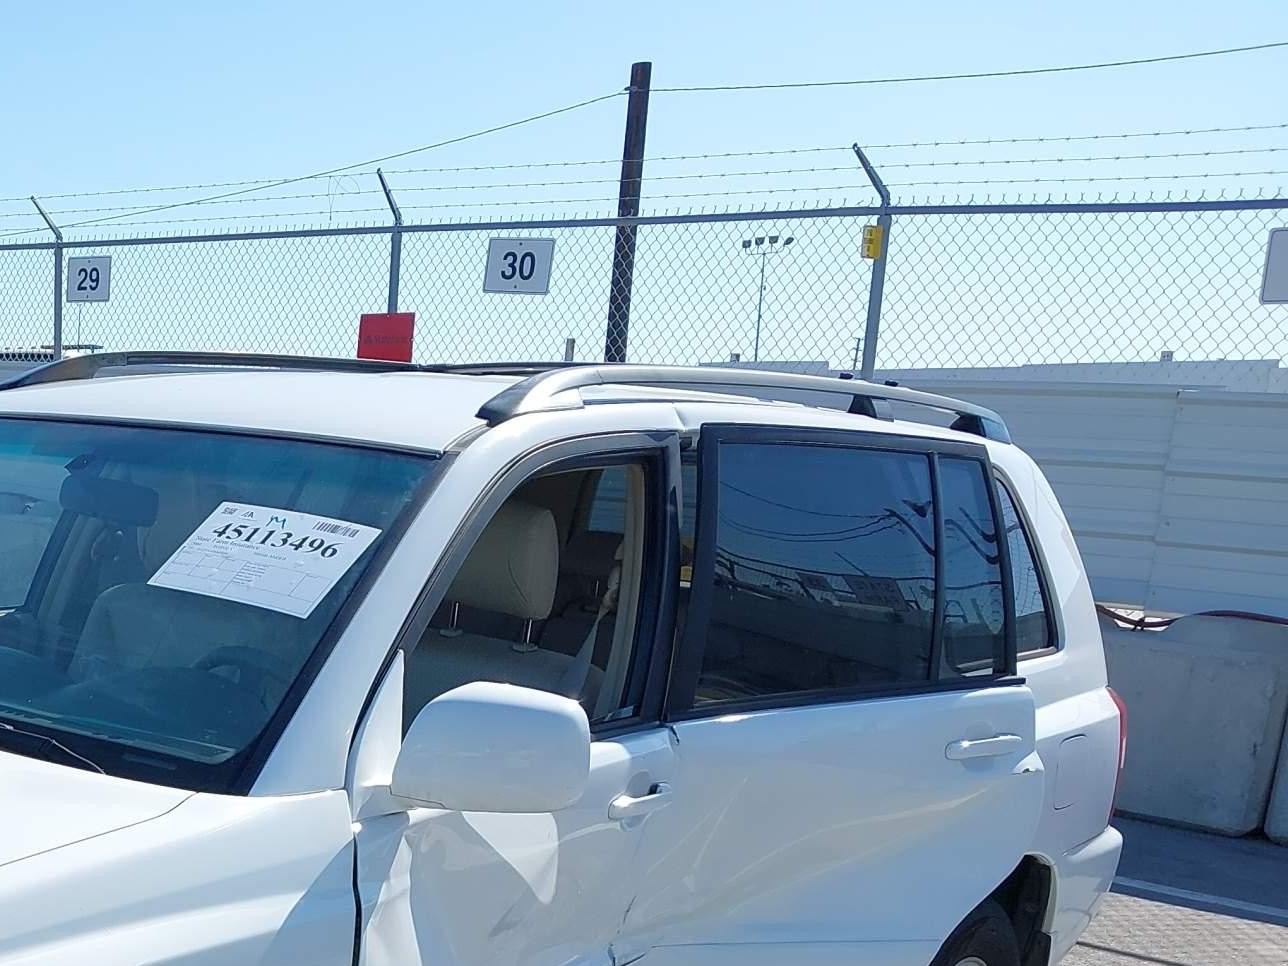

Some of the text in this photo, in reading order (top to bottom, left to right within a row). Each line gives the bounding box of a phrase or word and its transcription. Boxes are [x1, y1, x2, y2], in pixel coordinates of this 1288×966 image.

[76, 267, 100, 291] 29
[500, 251, 536, 281] 30
[212, 522, 344, 559] 45113496
